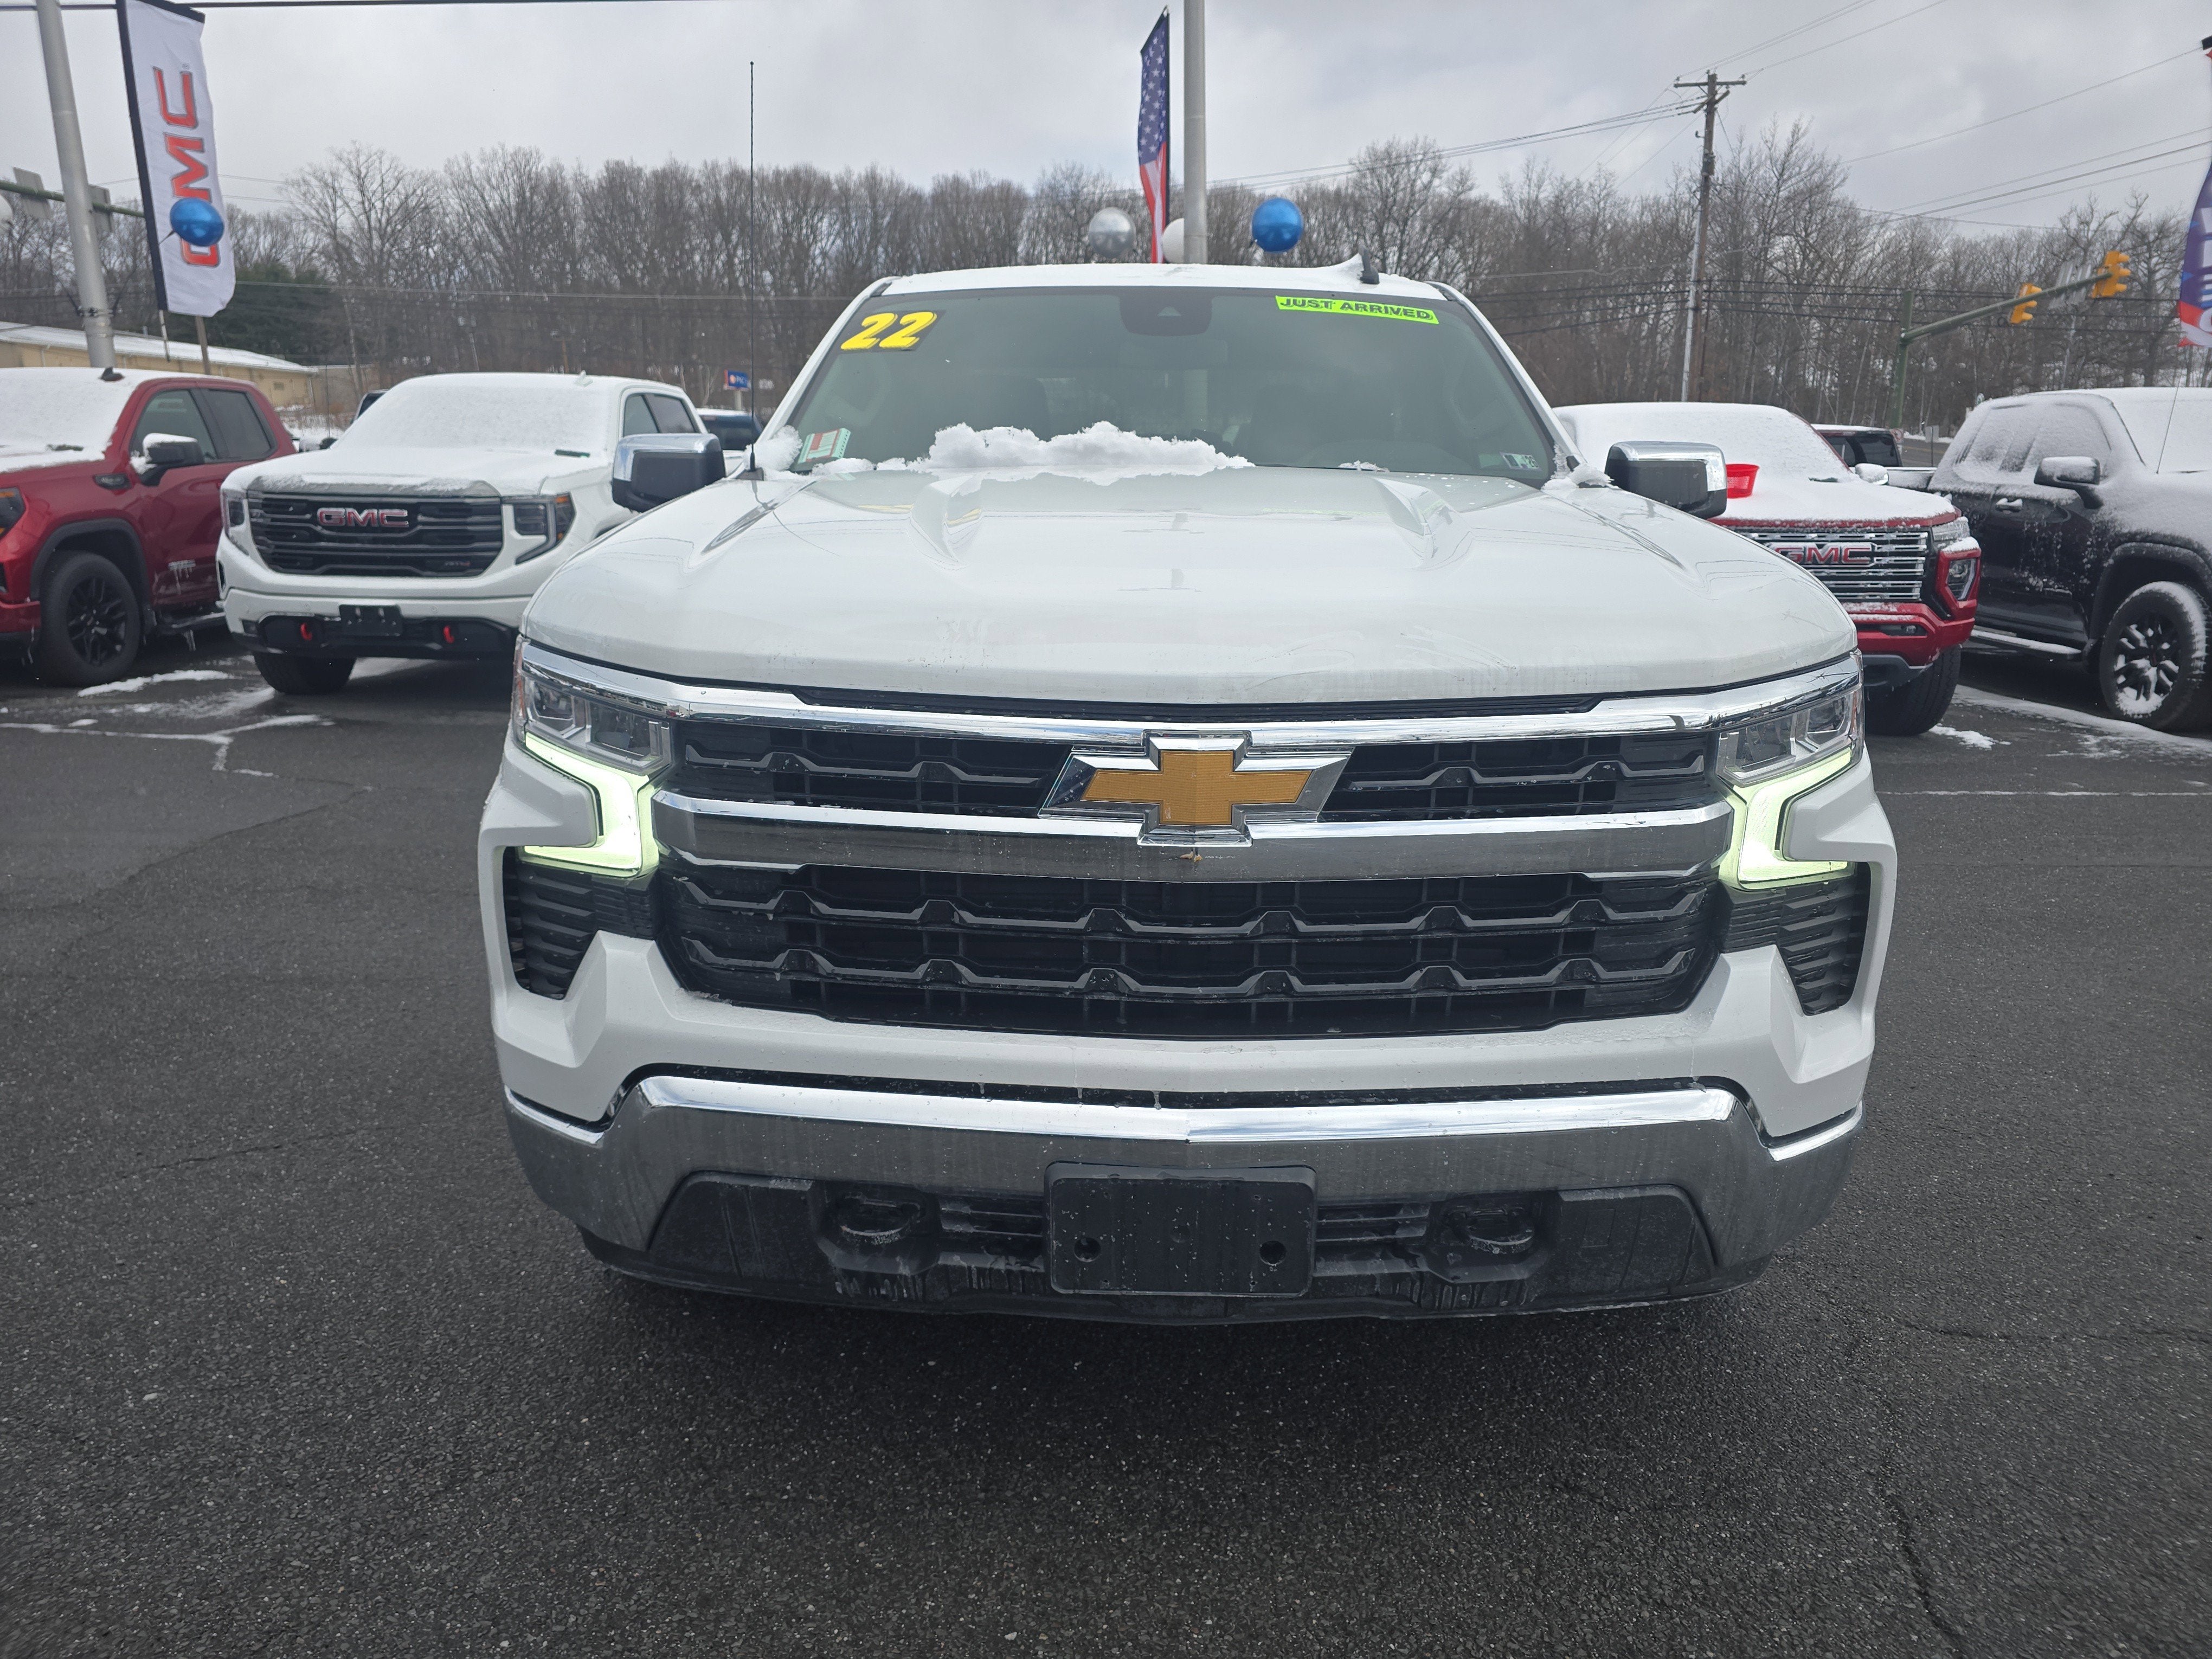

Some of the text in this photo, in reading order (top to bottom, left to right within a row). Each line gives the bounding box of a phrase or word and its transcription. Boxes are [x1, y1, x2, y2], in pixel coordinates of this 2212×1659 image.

[1280, 298, 1433, 320] JUST ARRIVED
[840, 311, 937, 350] 22
[317, 507, 409, 527] GMC
